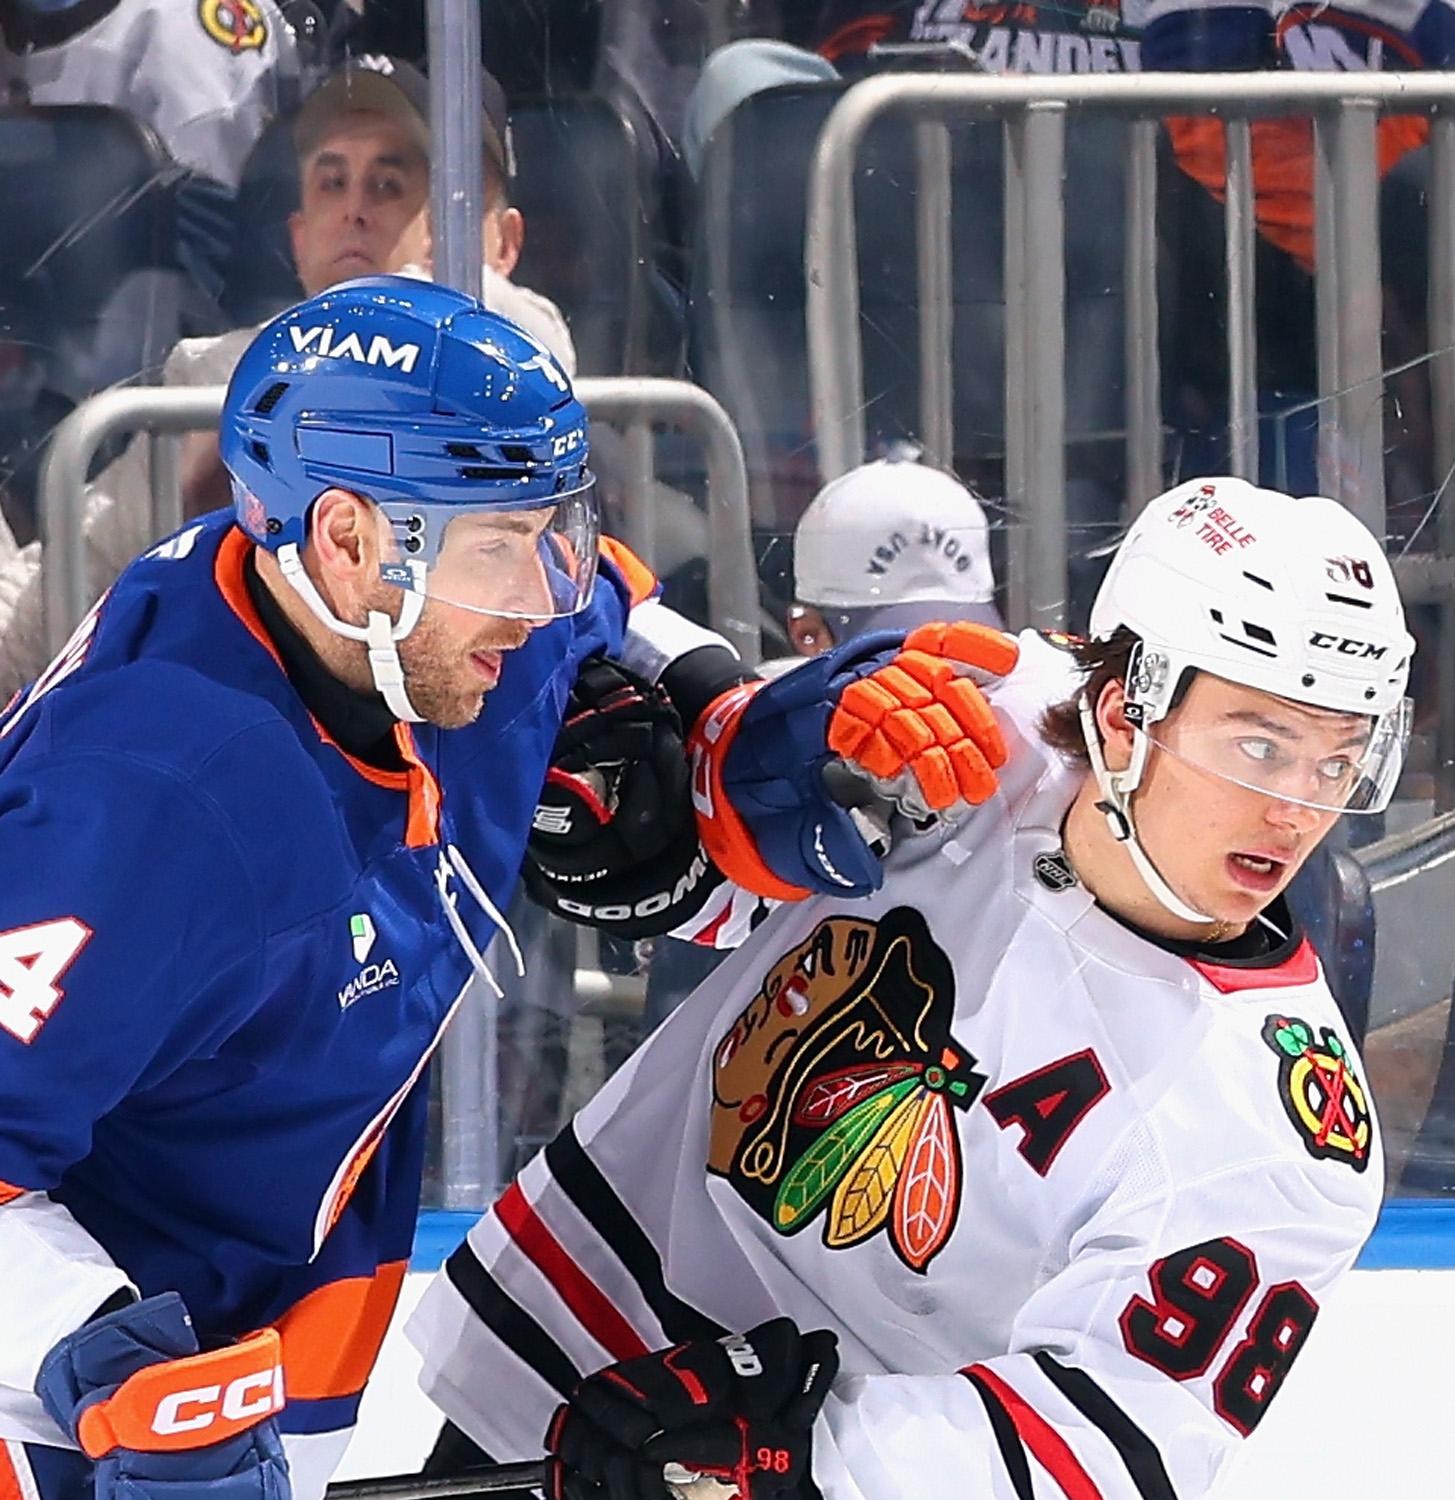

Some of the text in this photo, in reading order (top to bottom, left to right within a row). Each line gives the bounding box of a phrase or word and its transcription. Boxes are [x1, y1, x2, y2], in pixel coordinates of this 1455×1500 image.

[289, 326, 420, 373] VIAM
[551, 428, 585, 455] CC
[1195, 522, 1233, 556] TIRE
[1207, 507, 1257, 549] BELLE
[1308, 630, 1389, 661] CCM
[982, 1047, 1111, 1177] A
[1117, 1236, 1320, 1440] 98
[150, 1364, 285, 1436] CC
[757, 1447, 790, 1473] 98
